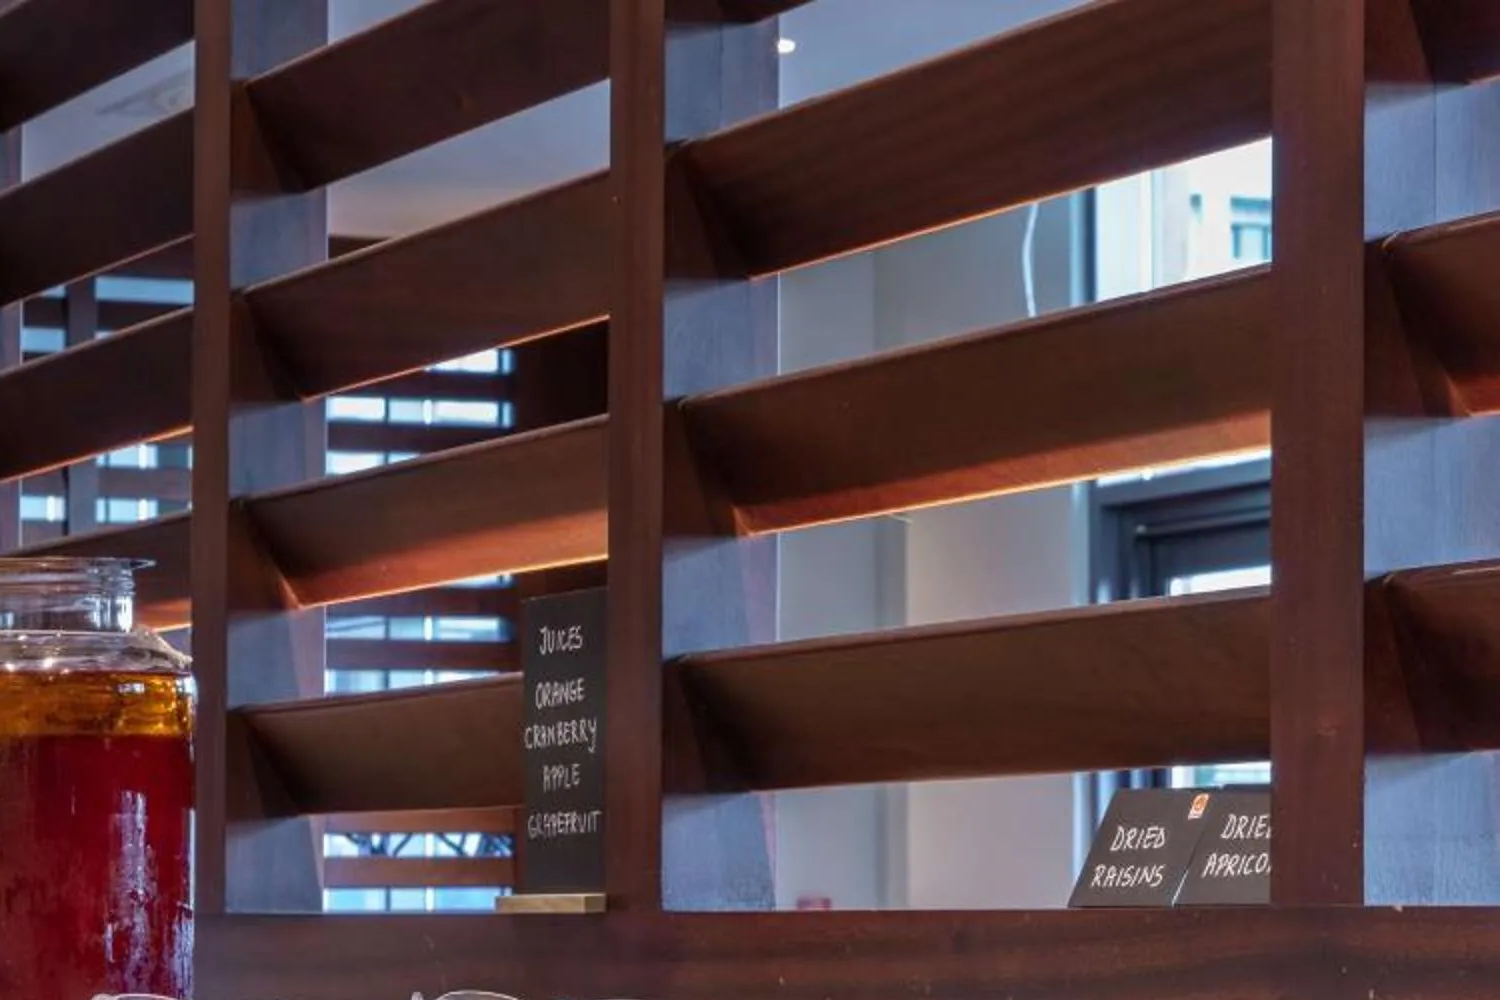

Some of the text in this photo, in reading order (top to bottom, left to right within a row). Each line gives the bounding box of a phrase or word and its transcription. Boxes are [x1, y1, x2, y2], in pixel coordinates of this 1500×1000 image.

[539, 626, 583, 654] JUICES
[535, 678, 585, 710] ORANGE
[525, 717, 598, 752] CRANBERRY
[543, 763, 581, 793] APPLE
[527, 810, 601, 839] GRAPEFRUIT
[1110, 825, 1167, 852] DRIED
[1221, 814, 1271, 839] DRIE
[1090, 864, 1167, 888] RAISINS
[1202, 852, 1271, 878] APRICO
